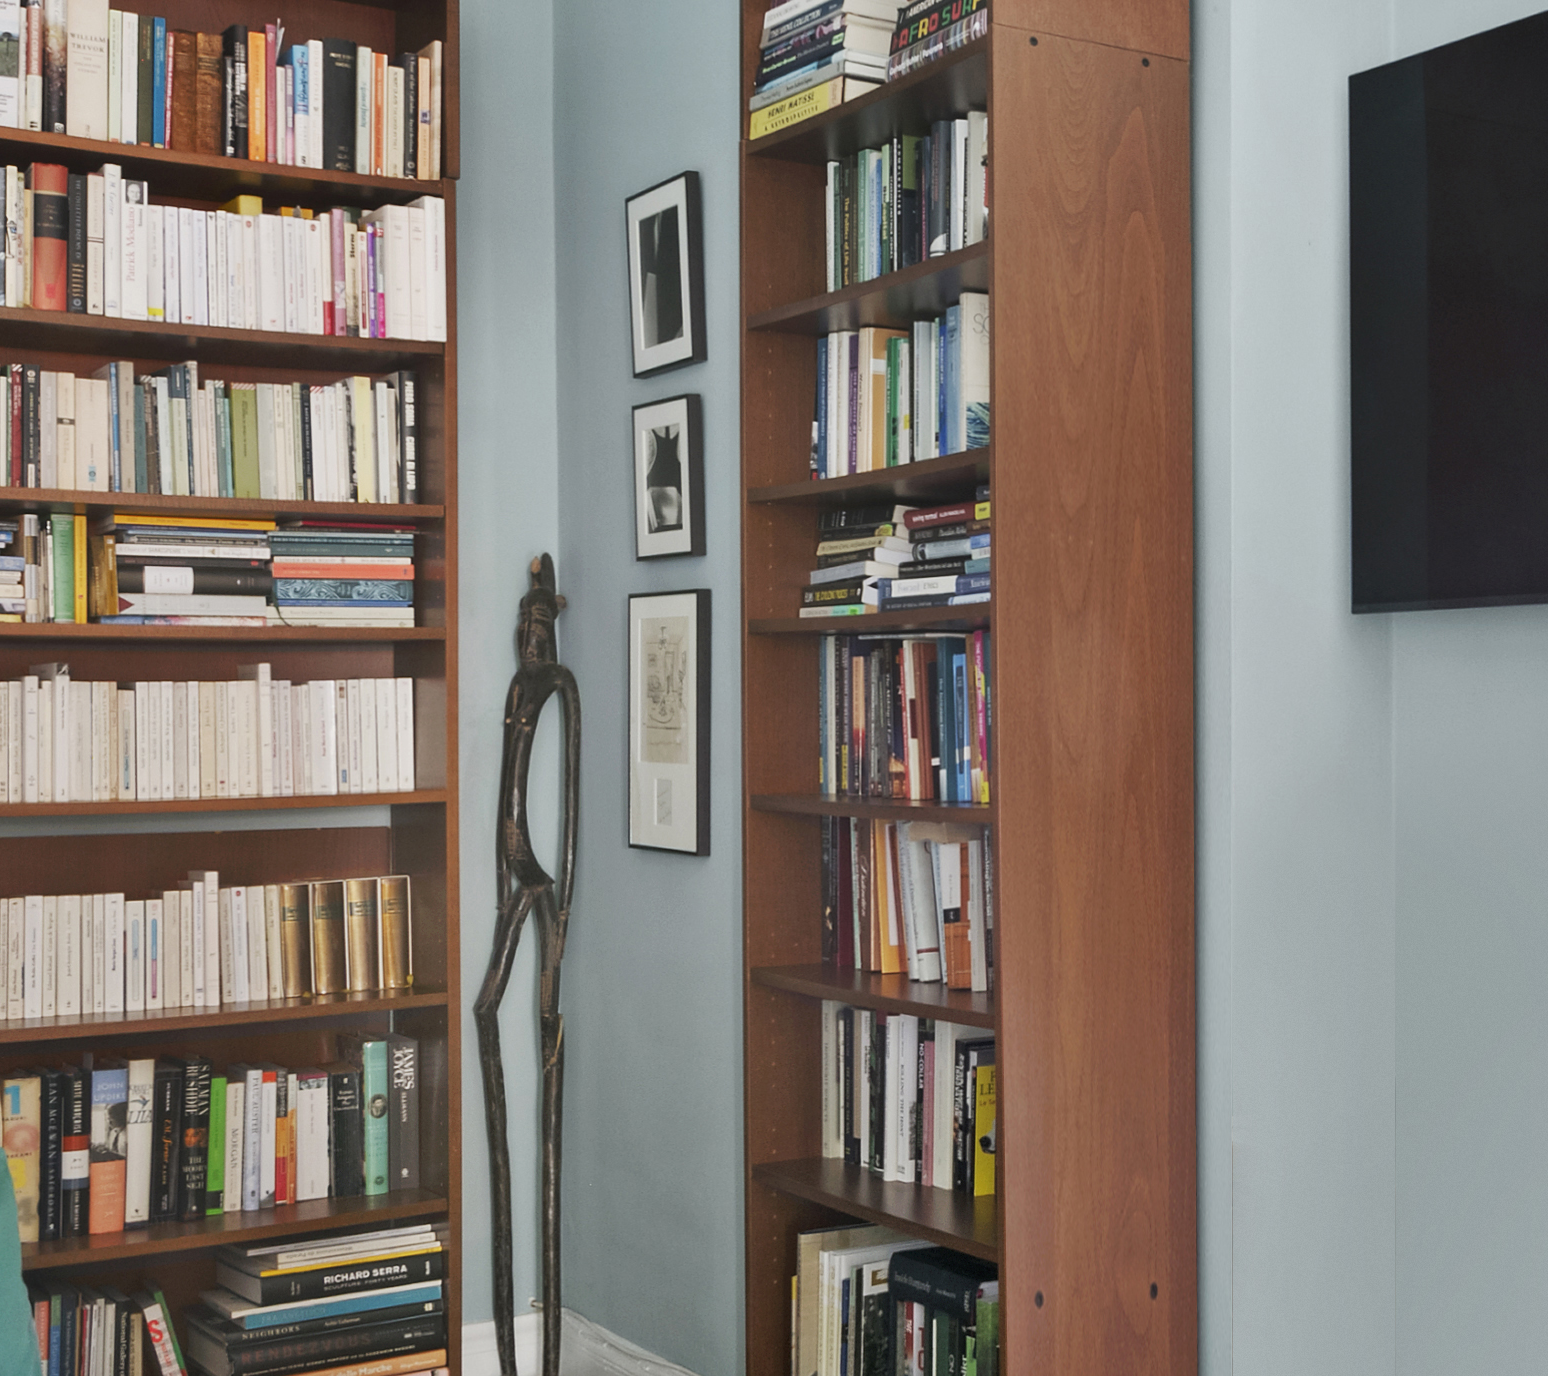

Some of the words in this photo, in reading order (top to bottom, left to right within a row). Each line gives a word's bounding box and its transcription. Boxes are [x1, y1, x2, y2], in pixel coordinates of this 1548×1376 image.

[795, 8, 822, 26] COLLECTION
[898, 12, 939, 47] AFRO
[71, 32, 106, 43] WILLIAM
[71, 42, 105, 53] TREVOR
[767, 102, 787, 118] HENRI
[788, 91, 815, 110] MATISSE
[126, 206, 136, 248] Modiano
[125, 250, 136, 282] Patrick
[405, 381, 415, 403] PIERO
[405, 404, 415, 427] SORIA
[405, 436, 415, 460] CUORE
[405, 471, 415, 490] LUPO
[393, 1048, 404, 1088] JOYCE
[403, 1047, 415, 1090] JAMES
[47, 1082, 56, 1104] IAN
[73, 1081, 82, 1098] SUITE
[93, 1092, 127, 1102] UPDIKE
[95, 1081, 124, 1091] JOHN
[184, 1065, 198, 1117] RUSHDIE
[198, 1064, 210, 1116] SALMAN
[252, 1077, 260, 1098] PAUL
[72, 1100, 82, 1134] FRANÇAISE
[252, 1102, 260, 1134] AUSTER
[47, 1109, 56, 1159] McEWAN
[230, 1128, 240, 1169] MORGAN
[324, 1267, 370, 1286] RICHARD
[372, 1263, 408, 1279] SERRA
[117, 1311, 128, 1344] National
[242, 1325, 301, 1340] NEIGHBORS
[116, 1345, 127, 1370] Gallery
[240, 1332, 373, 1366] RENDEZVOUS
